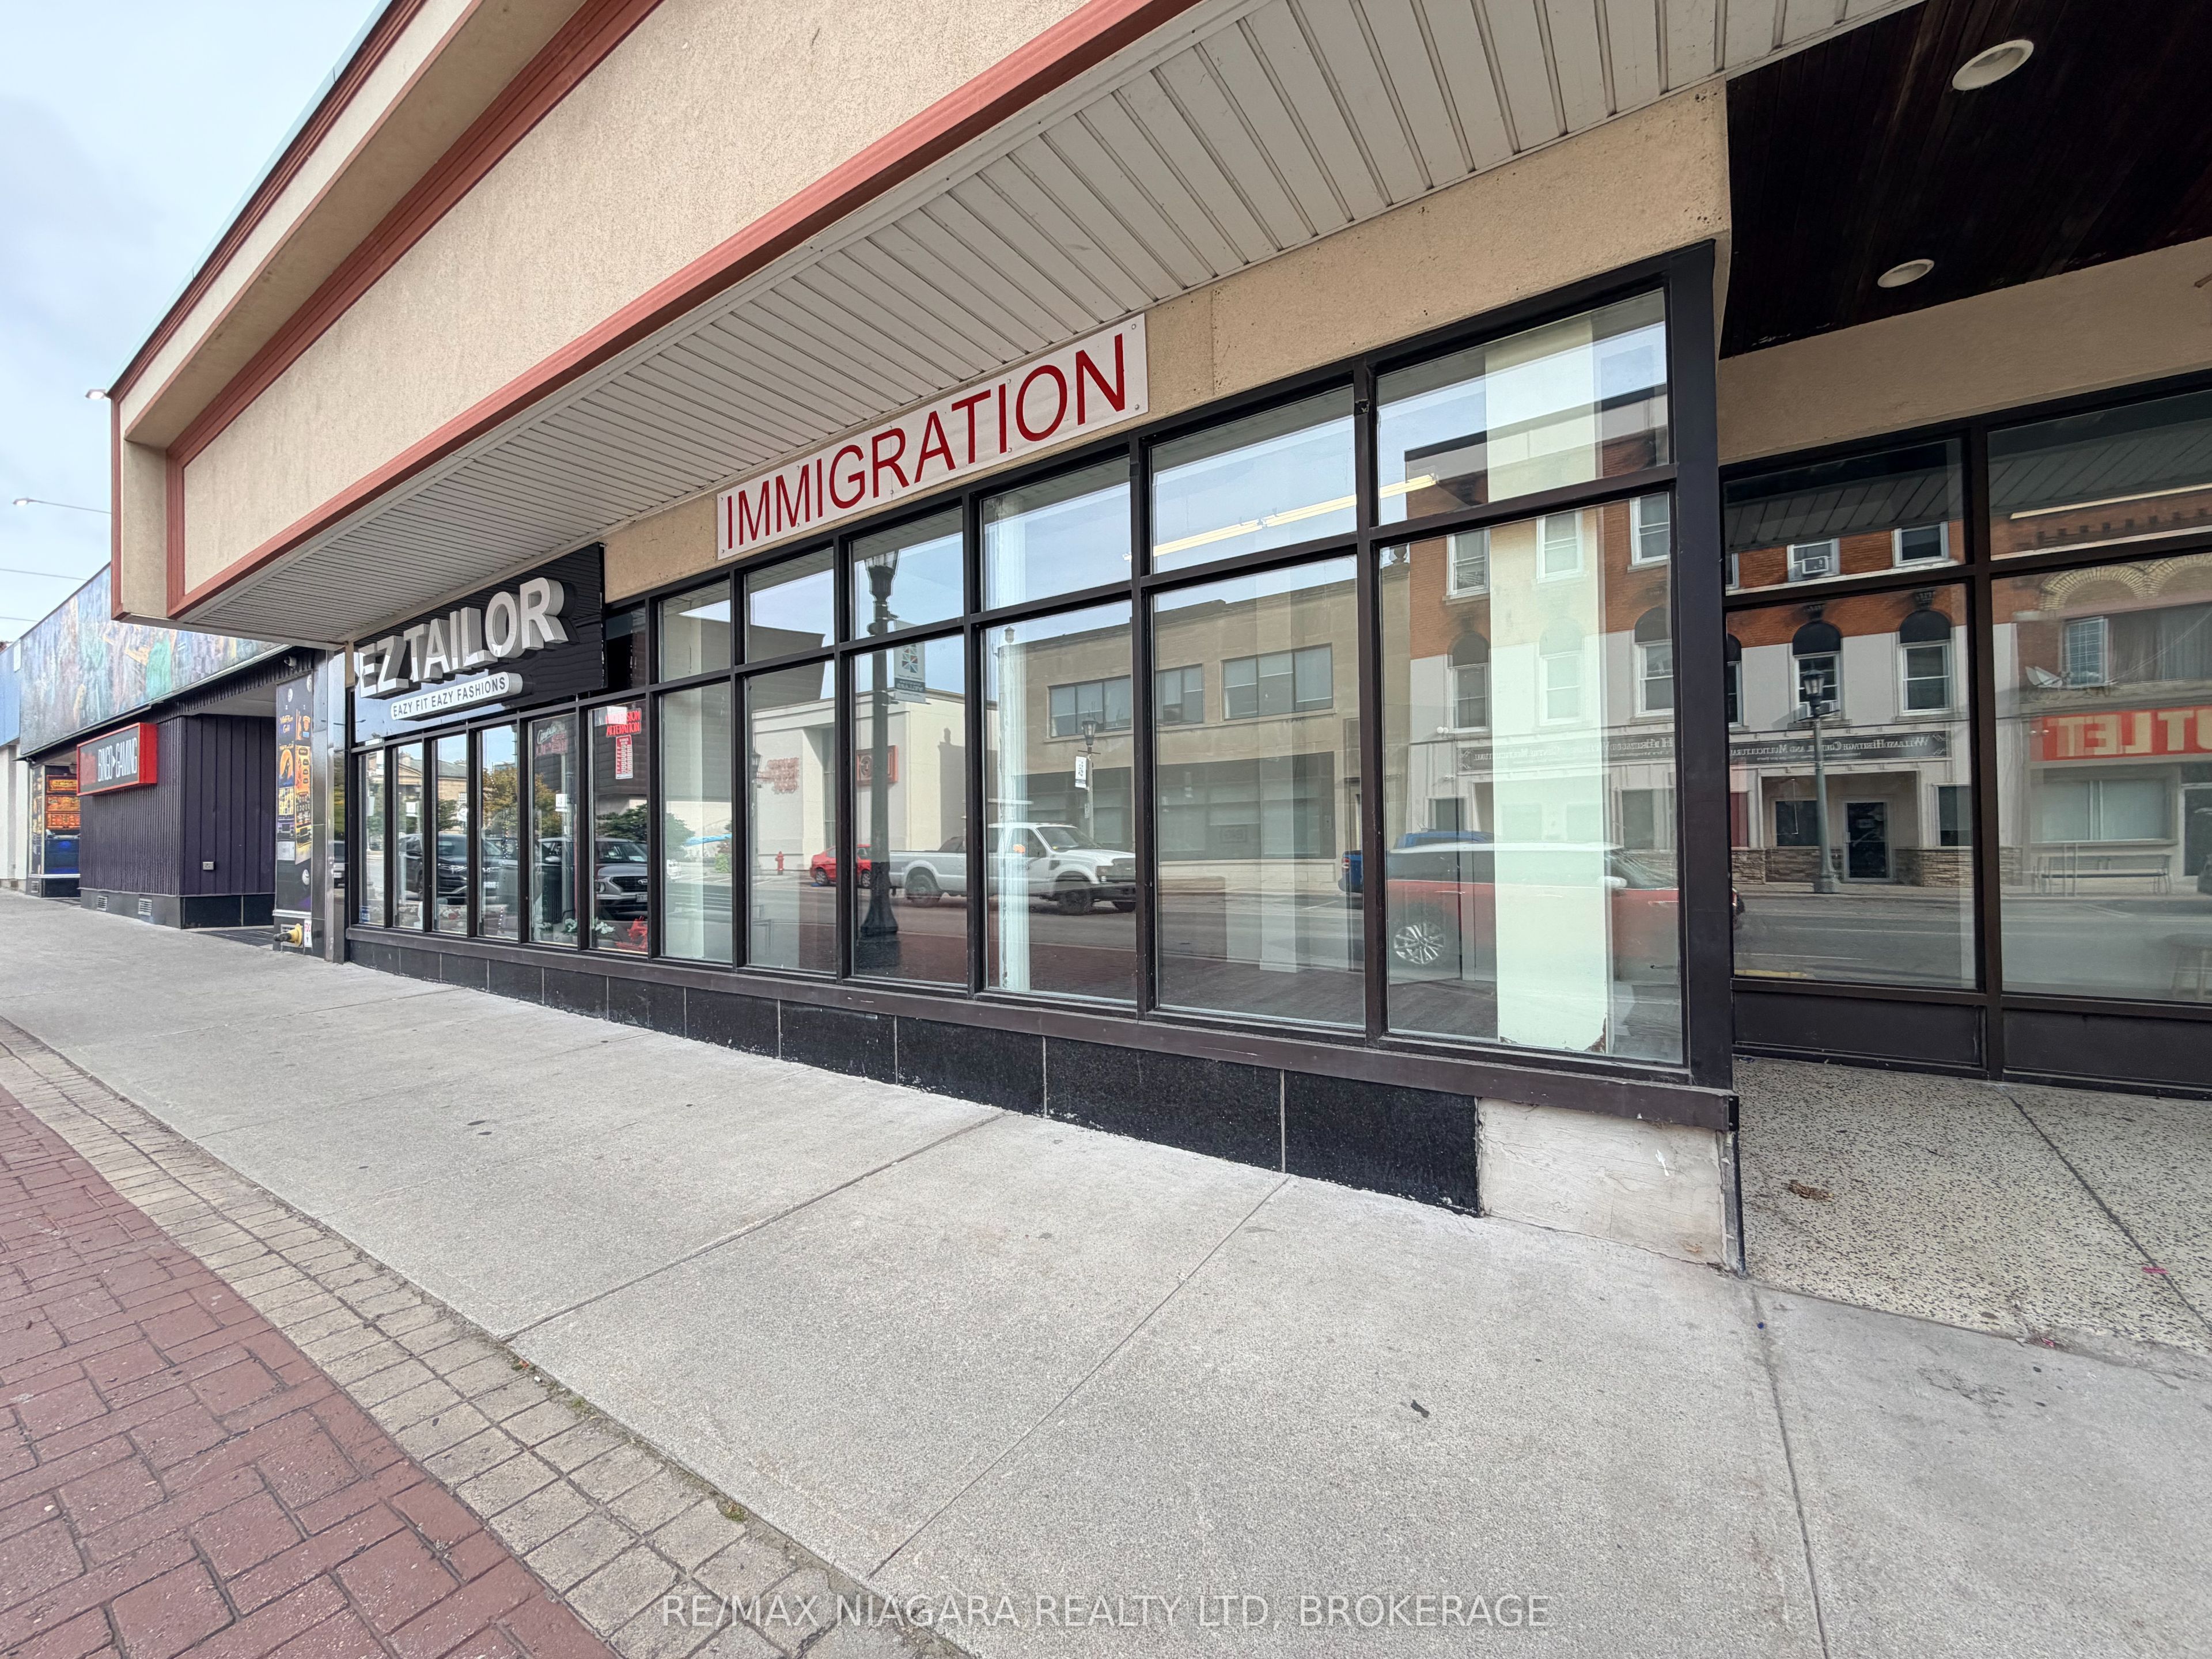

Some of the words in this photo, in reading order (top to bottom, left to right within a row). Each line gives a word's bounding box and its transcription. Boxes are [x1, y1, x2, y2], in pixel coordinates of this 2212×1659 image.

[726, 333, 1126, 550] IMMIGRATION
[358, 635, 408, 698] EZ
[403, 577, 568, 683] TAILOR
[393, 702, 412, 717] EAZY
[416, 698, 428, 711] FIT
[431, 691, 454, 708] EAZY
[457, 676, 506, 702] FASHIONS
[607, 721, 641, 736] ALTERATION
[116, 737, 138, 778] GAMING
